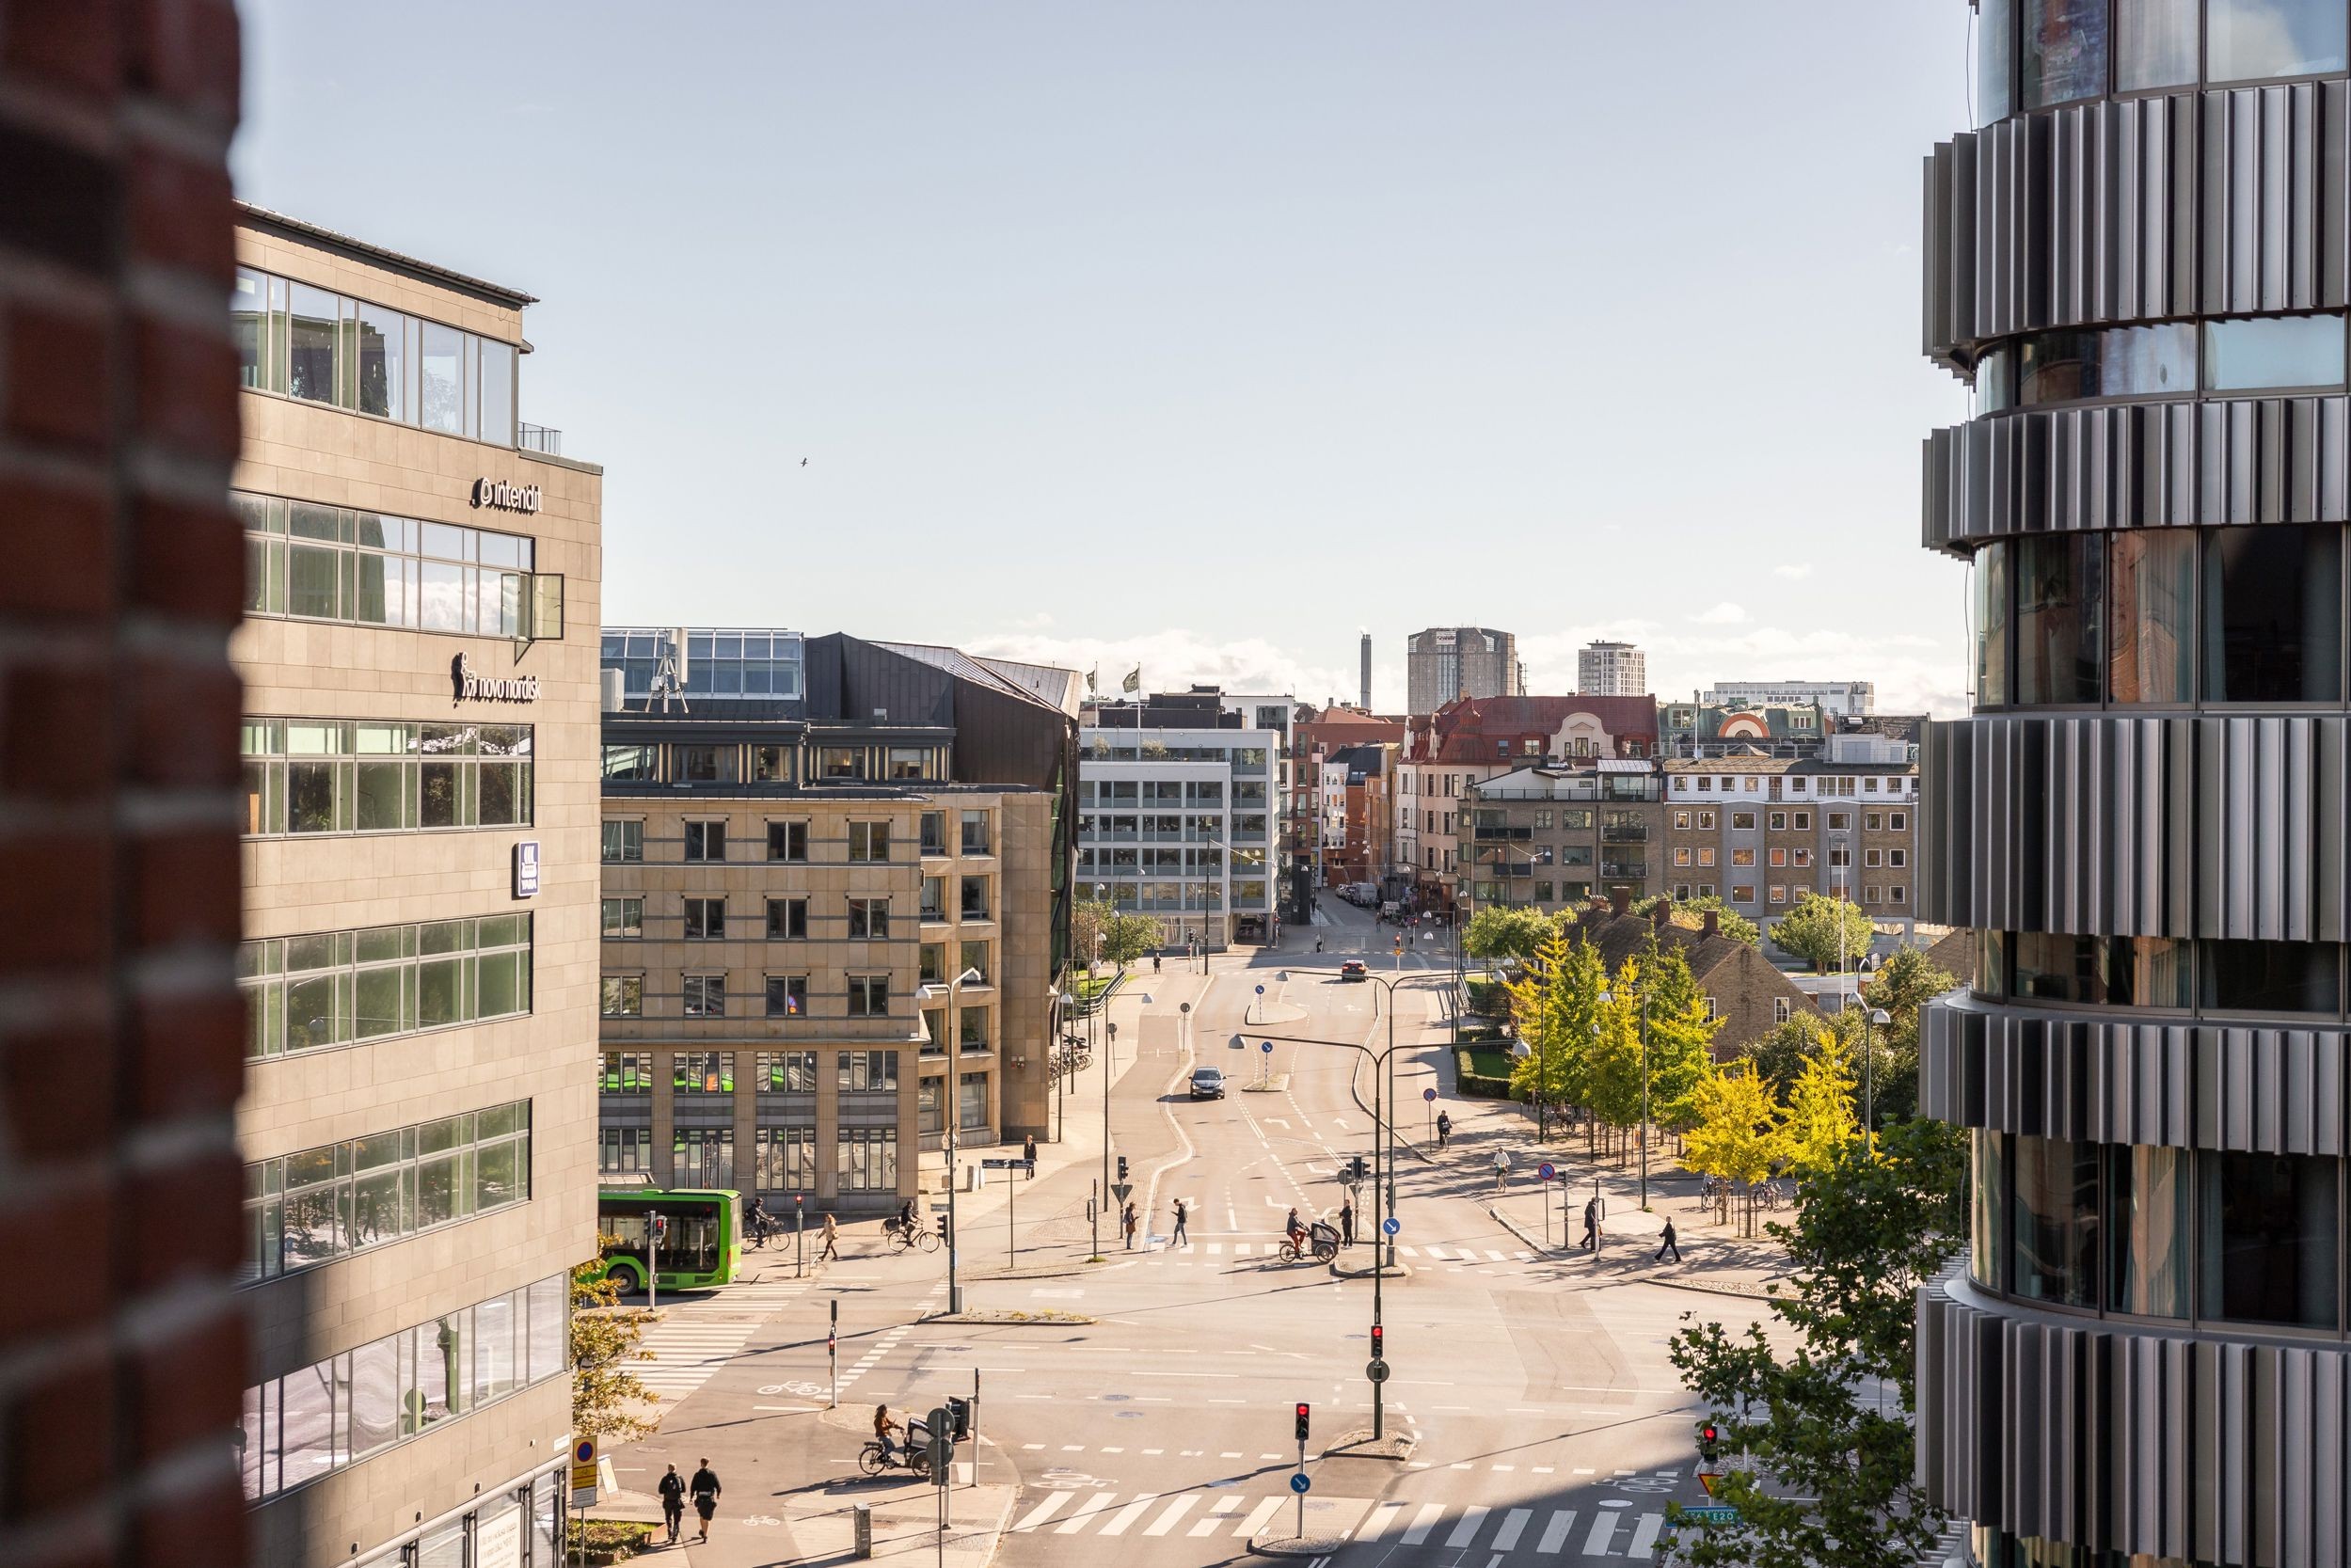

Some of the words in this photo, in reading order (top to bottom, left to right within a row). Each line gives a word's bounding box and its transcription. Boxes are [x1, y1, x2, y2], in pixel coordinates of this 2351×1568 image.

[494, 480, 543, 512] intendit
[479, 677, 504, 699] novo
[505, 674, 542, 700] nordisk
[1713, 1513, 1734, 1521] E20
